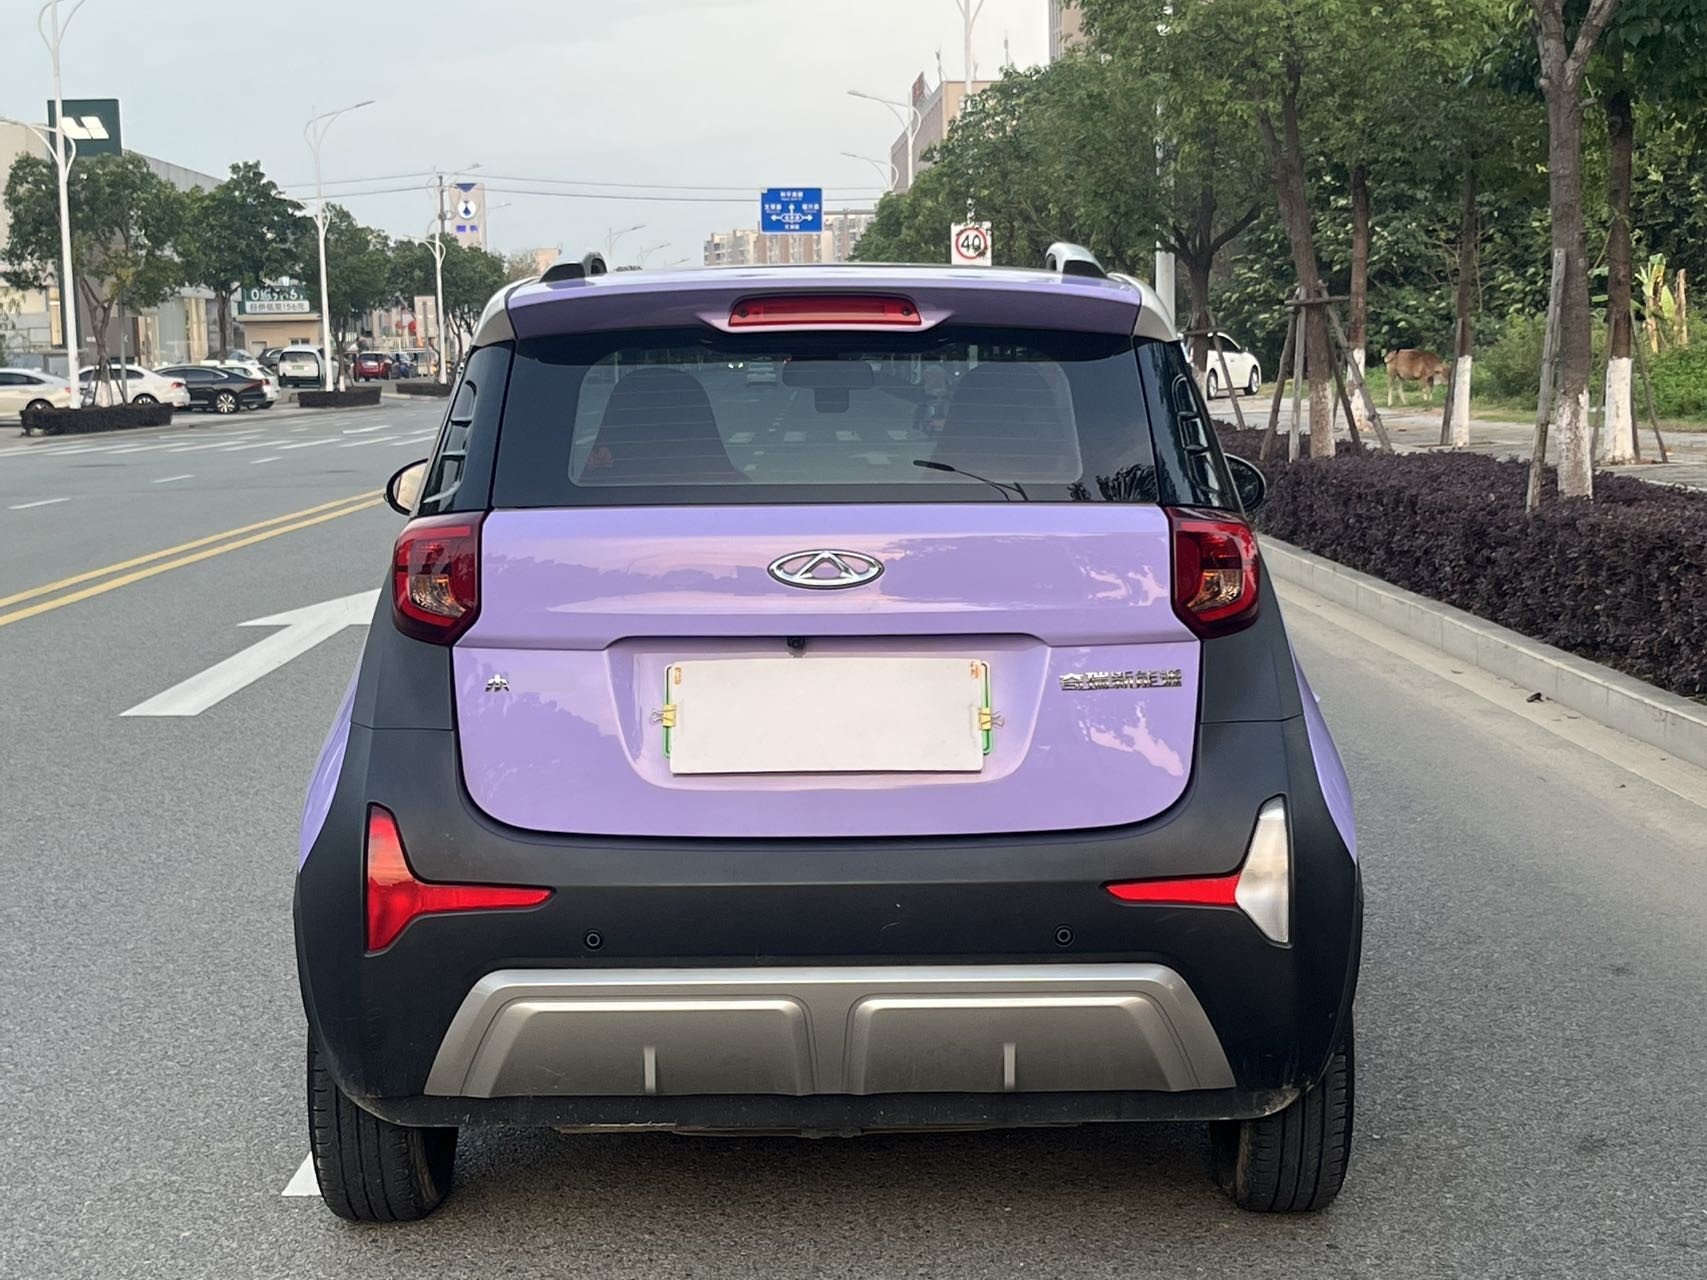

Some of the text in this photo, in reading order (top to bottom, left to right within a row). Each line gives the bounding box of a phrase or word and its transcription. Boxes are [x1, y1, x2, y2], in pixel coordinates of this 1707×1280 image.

[961, 234, 982, 252] 40
[1059, 669, 1182, 691] 奇瑞新能源
